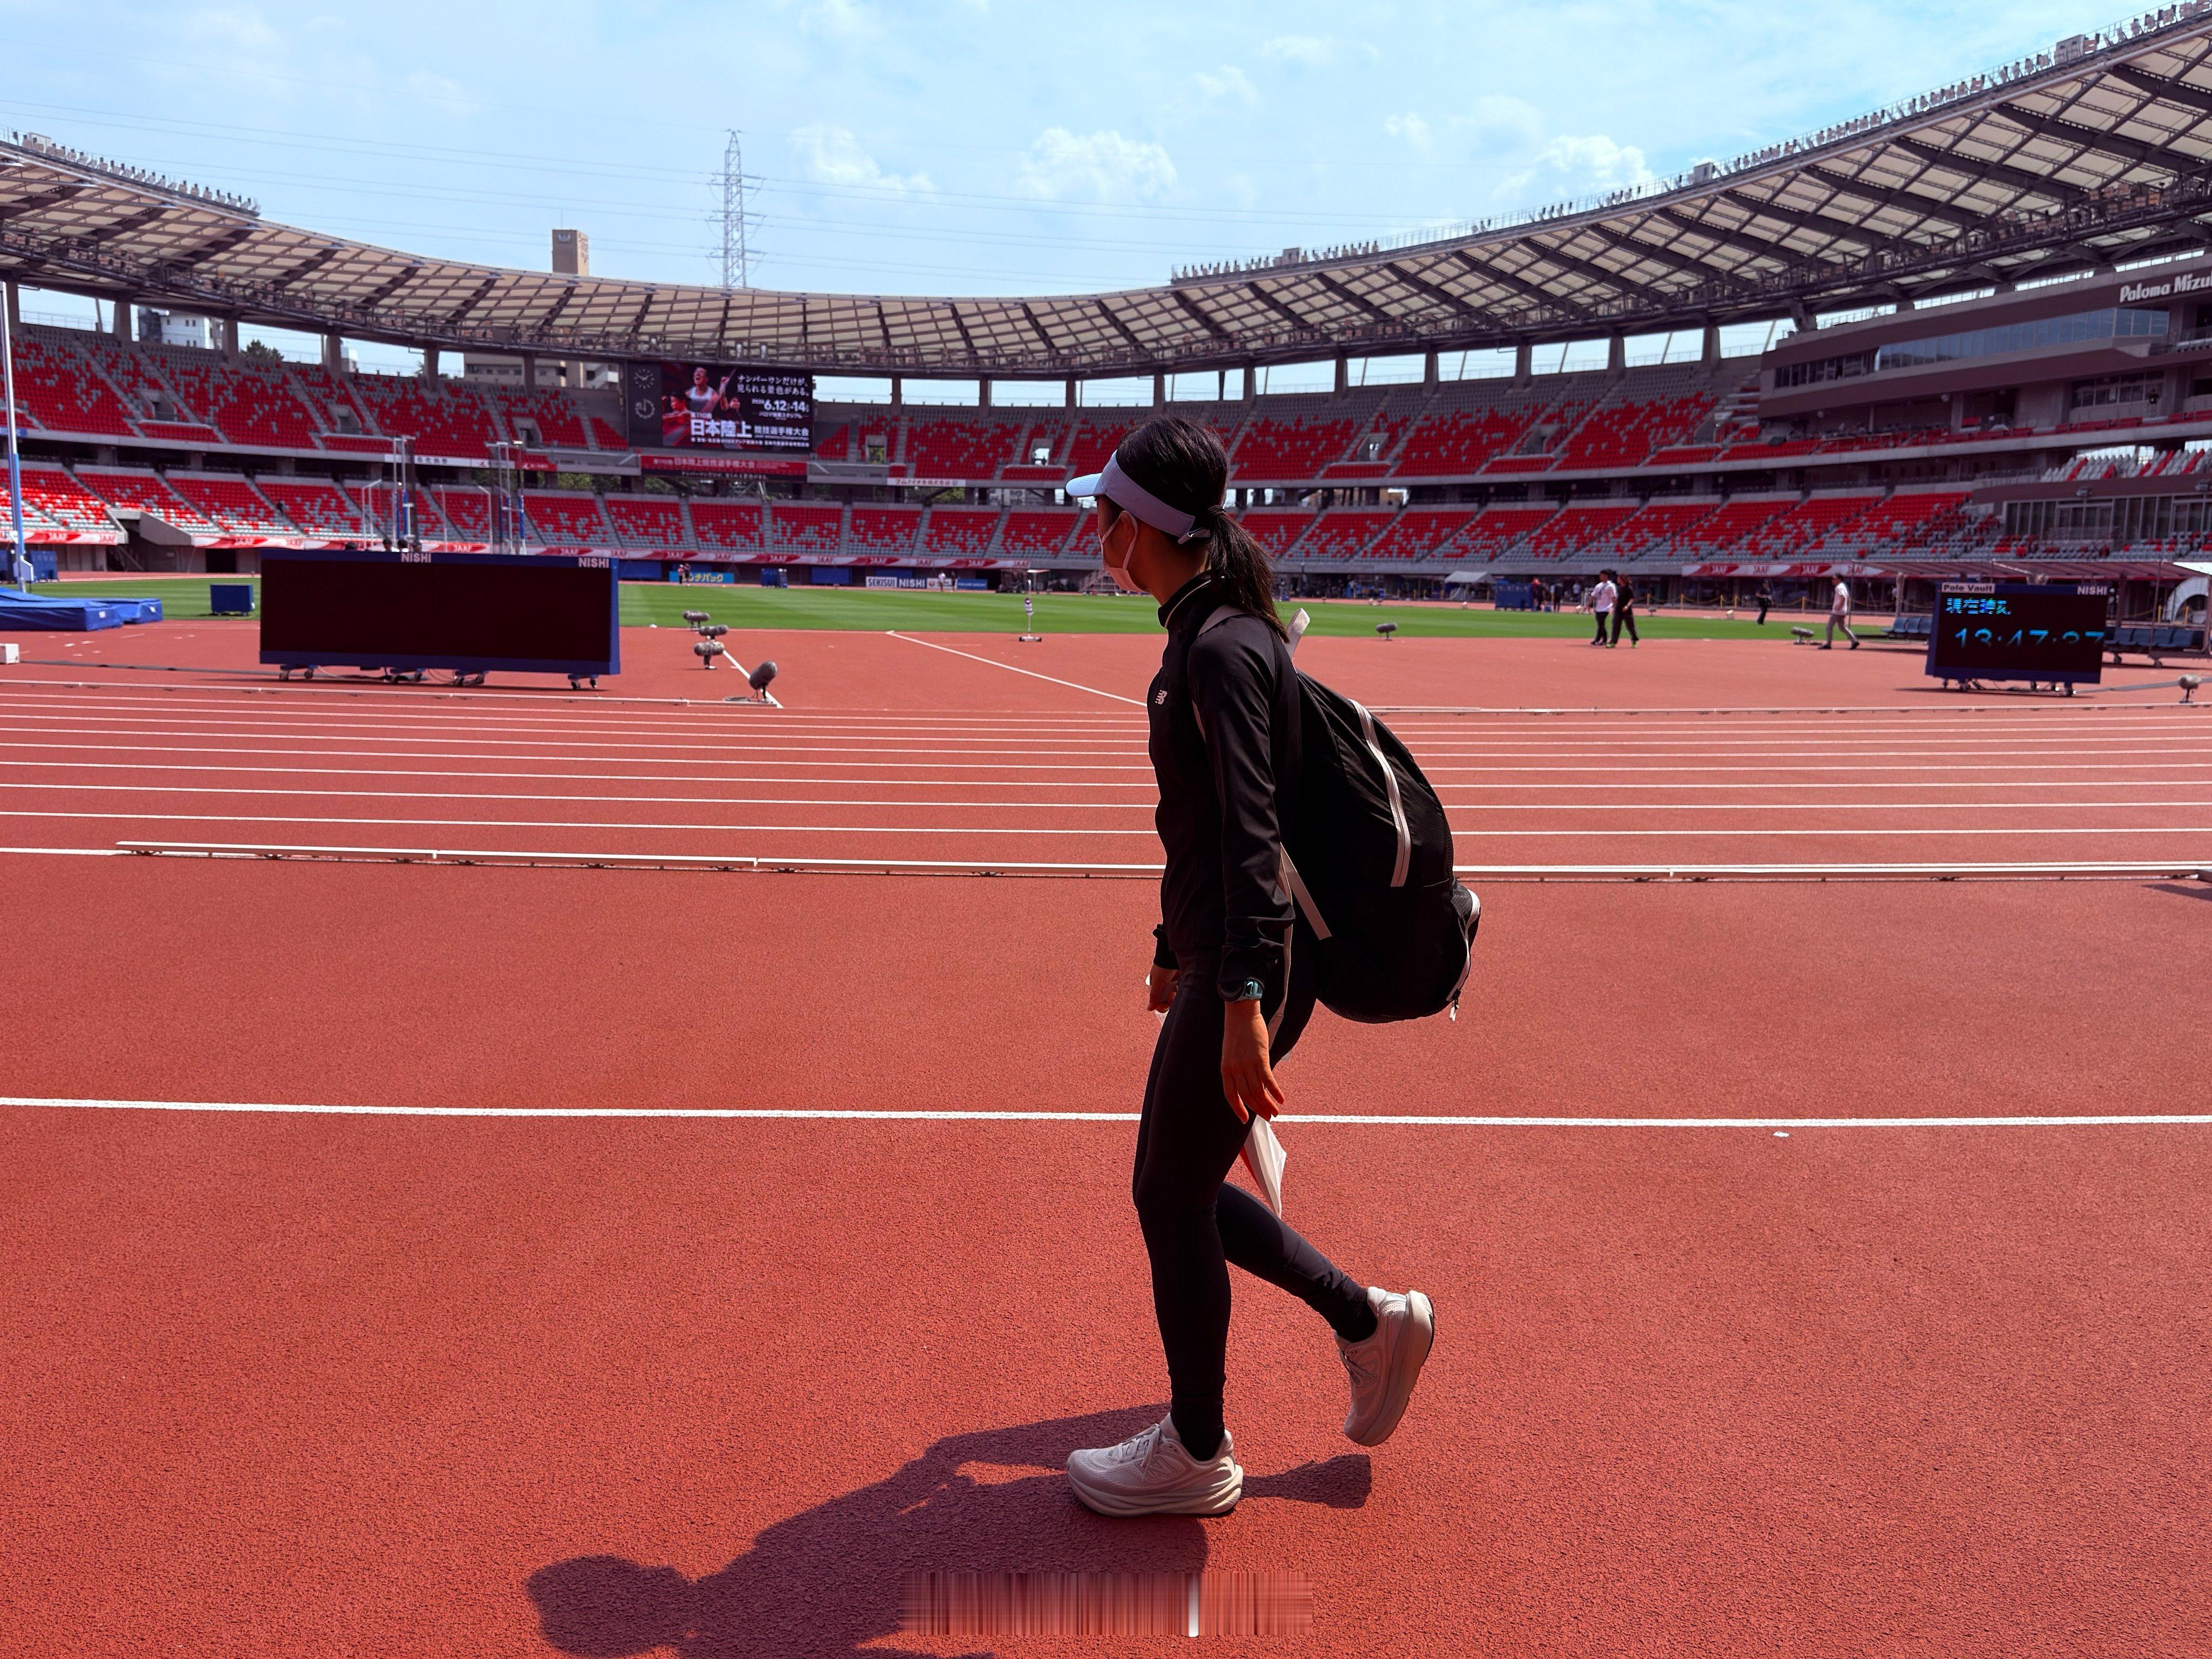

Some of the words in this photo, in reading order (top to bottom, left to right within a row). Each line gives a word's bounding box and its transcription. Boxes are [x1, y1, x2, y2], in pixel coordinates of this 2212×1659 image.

[2120, 283, 2171, 303] Paloma
[2174, 270, 2212, 293] Mizu
[401, 552, 431, 563] NISHI
[578, 557, 610, 568] NISHI
[867, 577, 896, 587] SEKISUI
[899, 578, 926, 588] NISHI
[1944, 584, 1965, 592] Pole
[1967, 584, 1993, 592] Vault
[2076, 585, 2108, 596] NISHI
